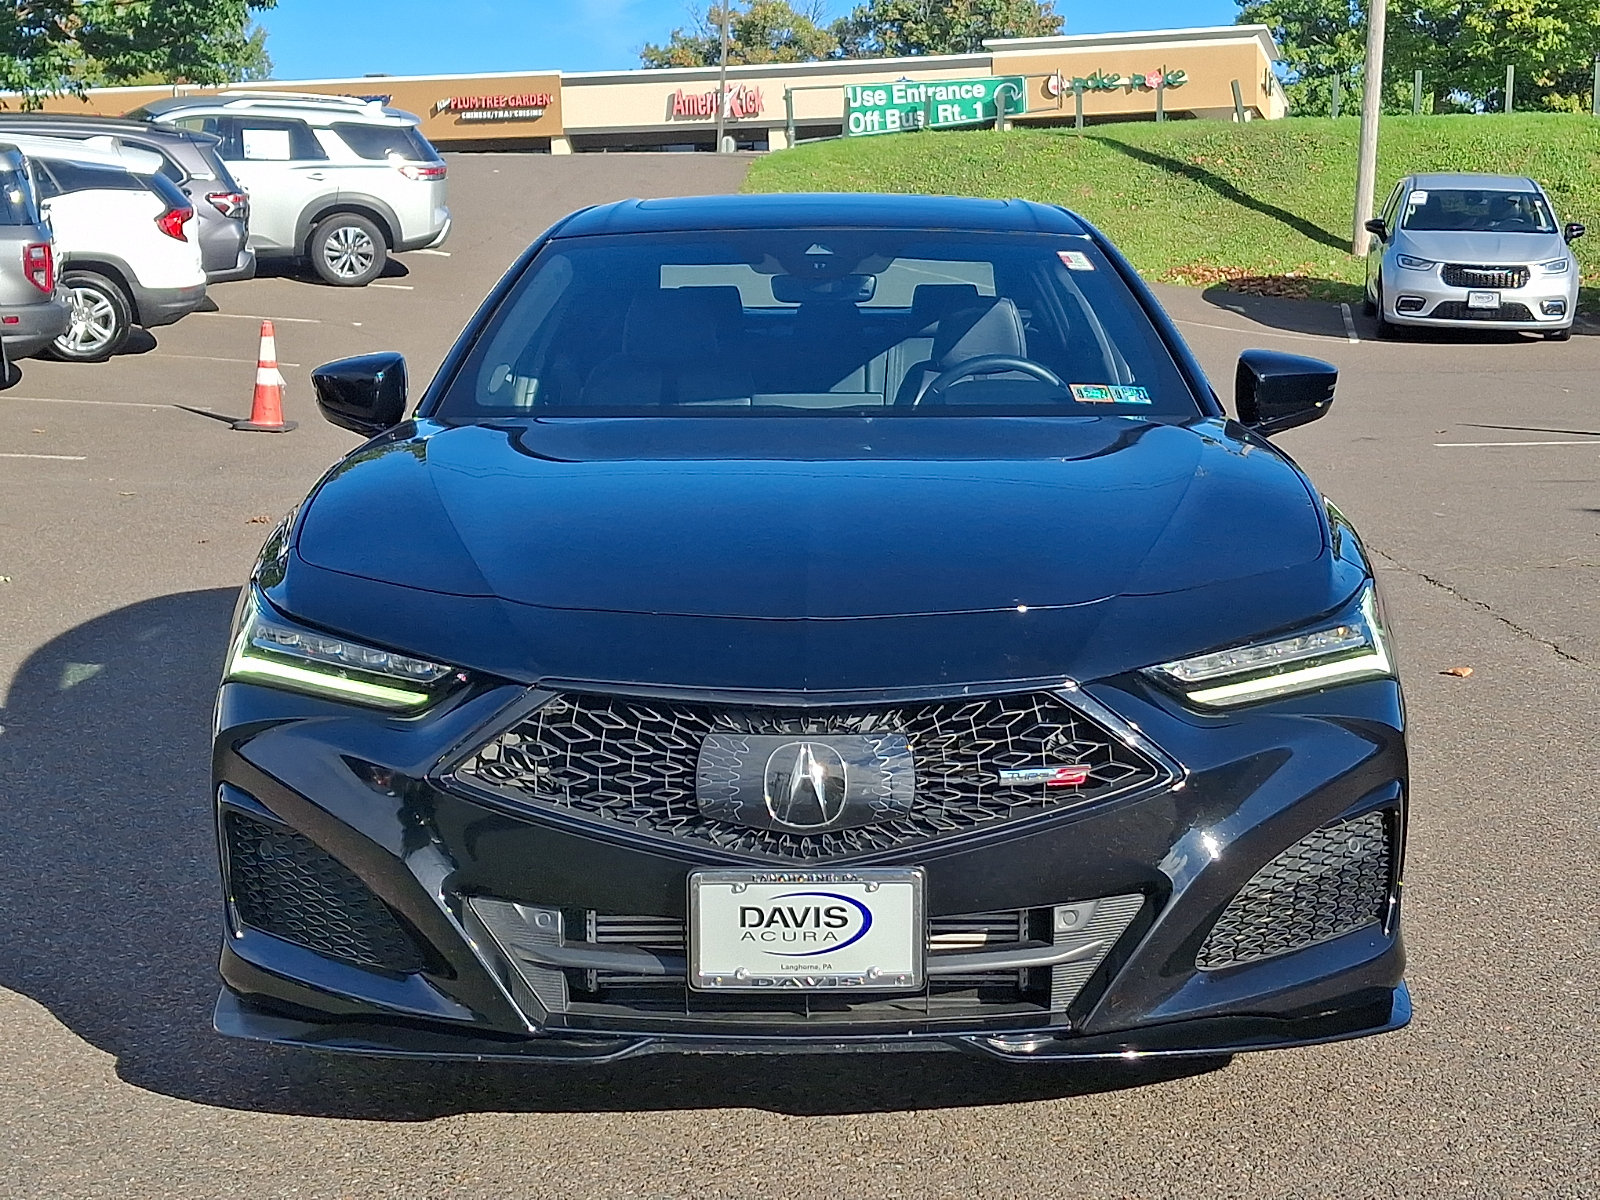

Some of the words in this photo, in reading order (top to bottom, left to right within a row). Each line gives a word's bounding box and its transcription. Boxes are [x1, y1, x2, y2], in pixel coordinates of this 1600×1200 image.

[450, 96, 480, 109] PLUM
[480, 94, 507, 108] TREE
[508, 92, 551, 107] GARDEN
[847, 87, 887, 107] Use
[892, 83, 986, 104] Entrance
[937, 104, 967, 122] Rt.
[972, 101, 983, 118] 1
[739, 905, 849, 929] DAVIS
[741, 931, 839, 942] ACURA
[780, 963, 821, 971] Langhorne,
[751, 976, 865, 988] DAVIS
